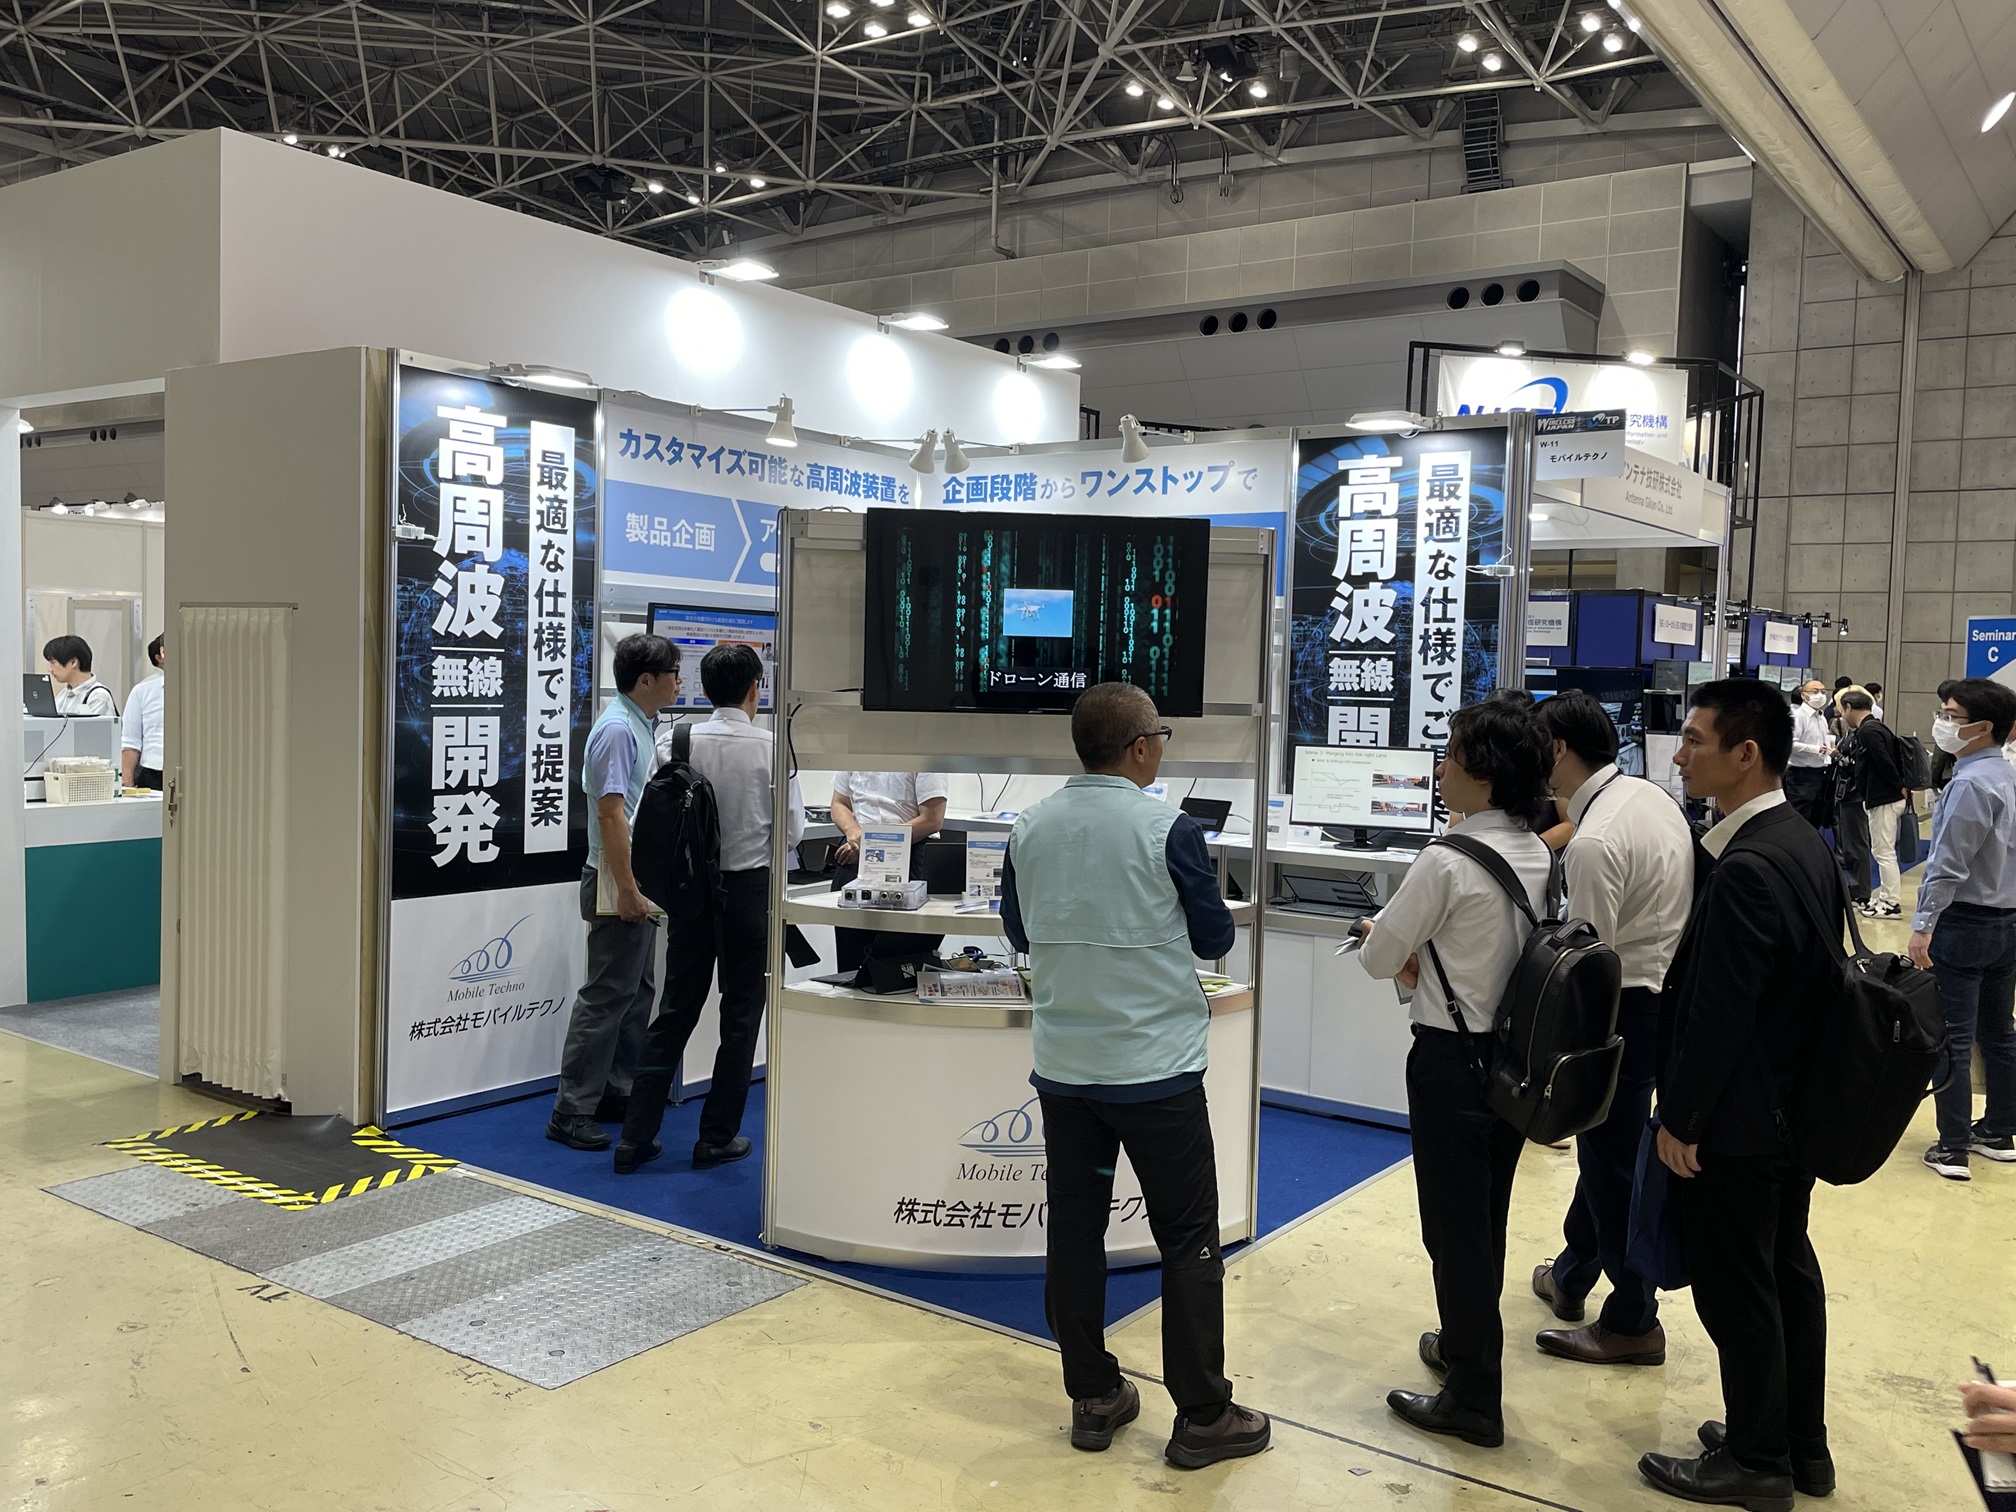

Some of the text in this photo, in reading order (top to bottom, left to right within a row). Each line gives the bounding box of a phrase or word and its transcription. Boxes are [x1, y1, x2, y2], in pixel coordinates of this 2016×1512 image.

[1625, 413, 1668, 429] 究機構
[1540, 440, 1559, 448] W-11
[1549, 451, 1608, 463] モバイルテクノ
[619, 428, 909, 506] カスタマイズ可能な高周波装置を
[942, 459, 1258, 505] 企画段階からワンストップで
[1619, 461, 1683, 499] ンテナ技研株式会社
[431, 404, 507, 640] 高周波
[624, 511, 716, 553] 製品企画
[1329, 453, 1403, 645] 高周波
[530, 449, 570, 828] 最適な仕様でご提案
[1418, 463, 1462, 824] 最適な仕様でご
[1971, 629, 2016, 642] Seminar
[1987, 646, 1999, 663] C
[431, 654, 503, 698] 無線
[989, 670, 1087, 689] ドローン通信
[1328, 656, 1394, 693] 無線
[427, 715, 501, 868] 開発
[447, 980, 525, 1003] Mobile Techno
[408, 997, 565, 1042] 株式会社モバイルテクノ
[956, 1163, 1023, 1182] Mobile
